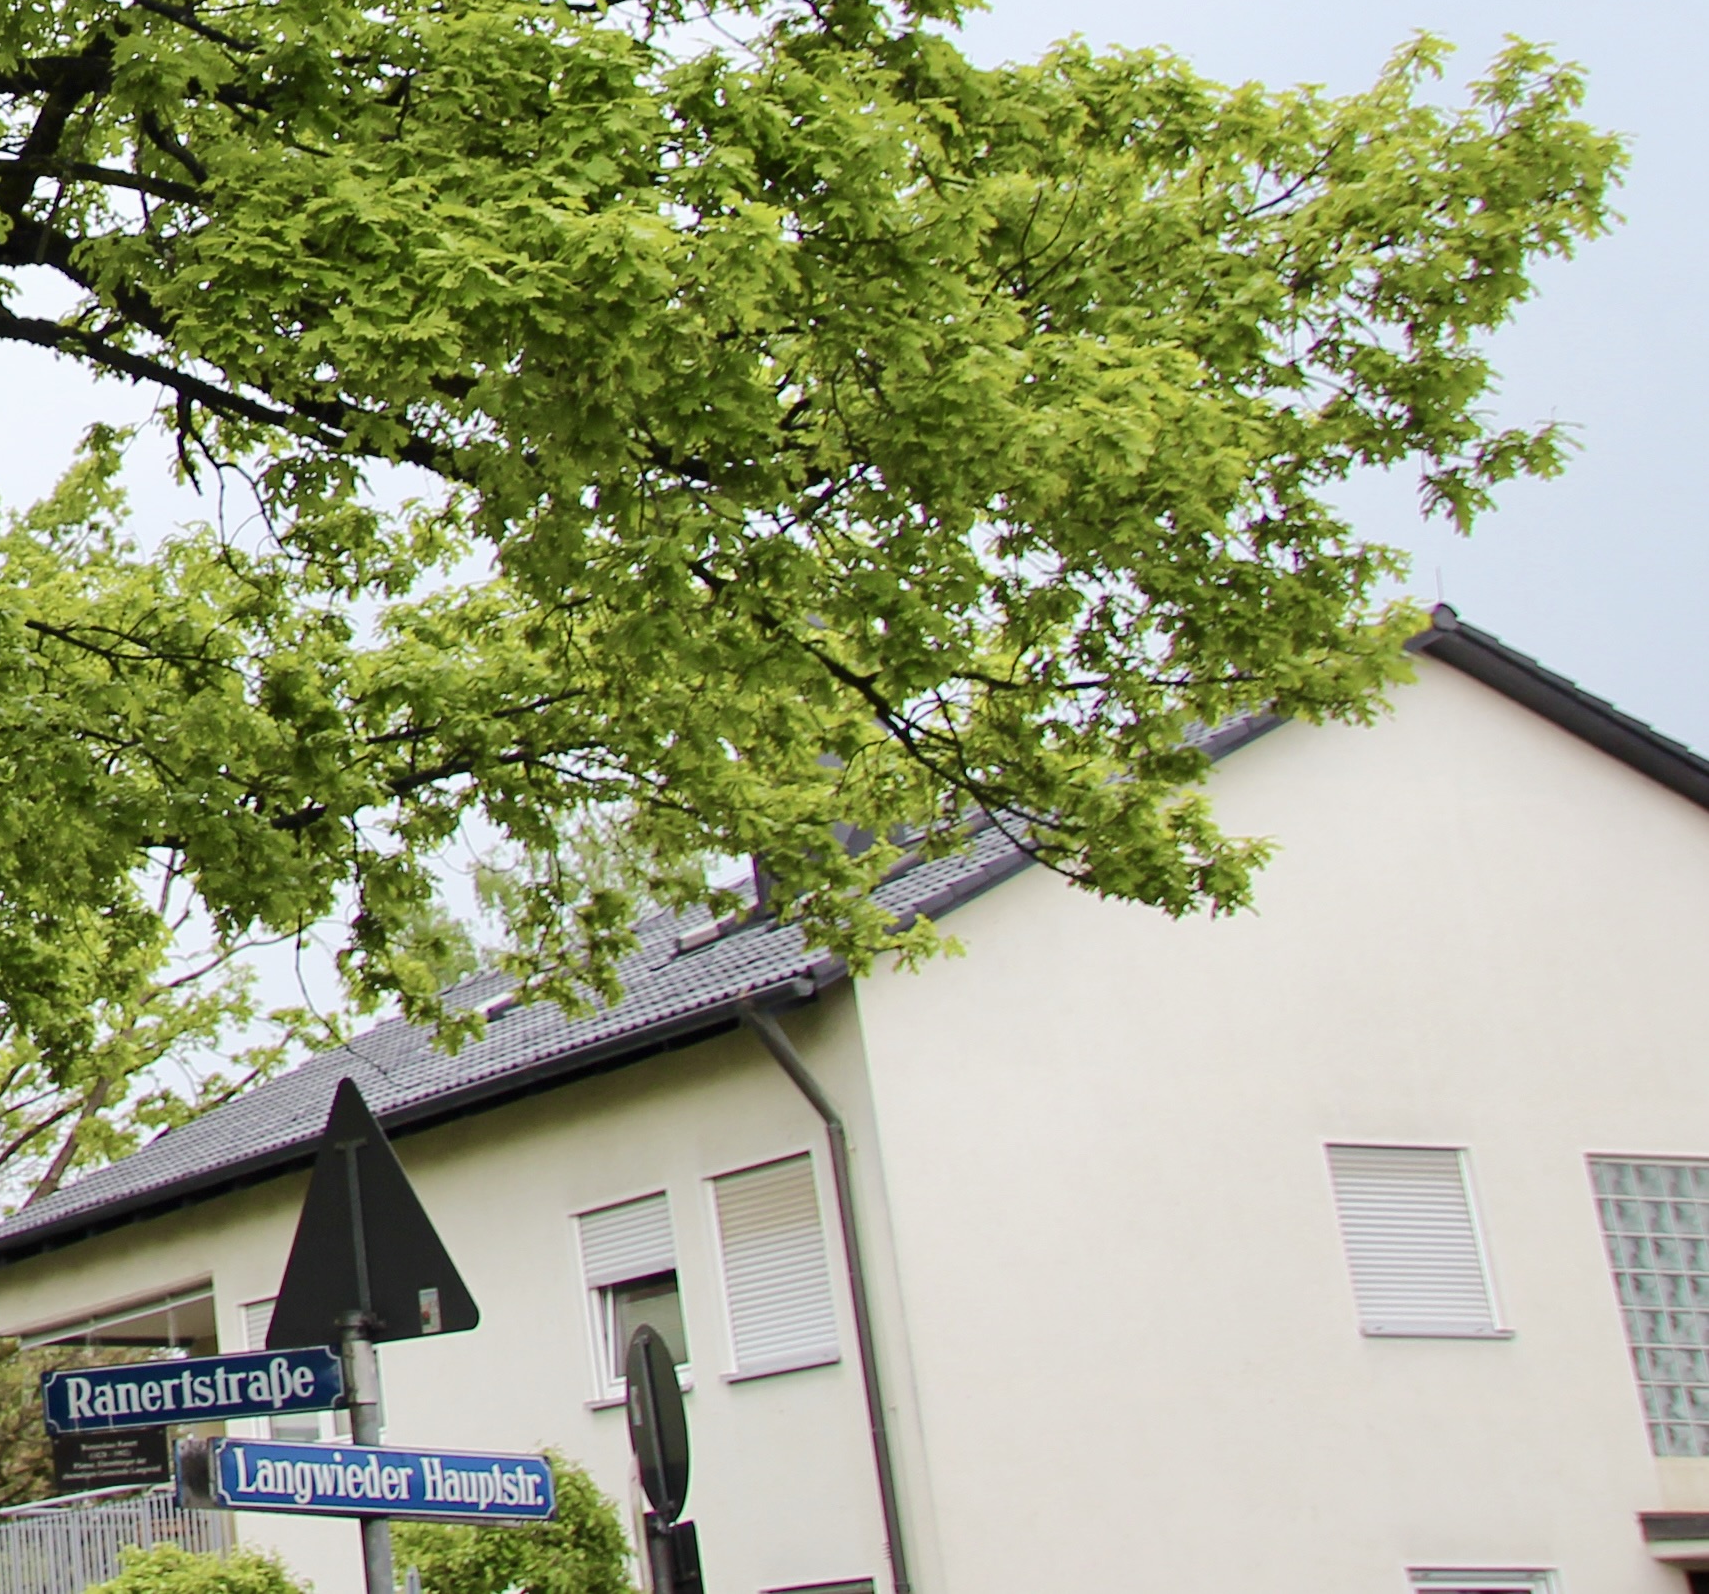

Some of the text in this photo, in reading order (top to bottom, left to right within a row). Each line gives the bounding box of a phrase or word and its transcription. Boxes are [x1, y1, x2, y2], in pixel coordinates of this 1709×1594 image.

[66, 1357, 315, 1419] Ranertstraße
[234, 1446, 545, 1511] Langwieder Hauptstr.
